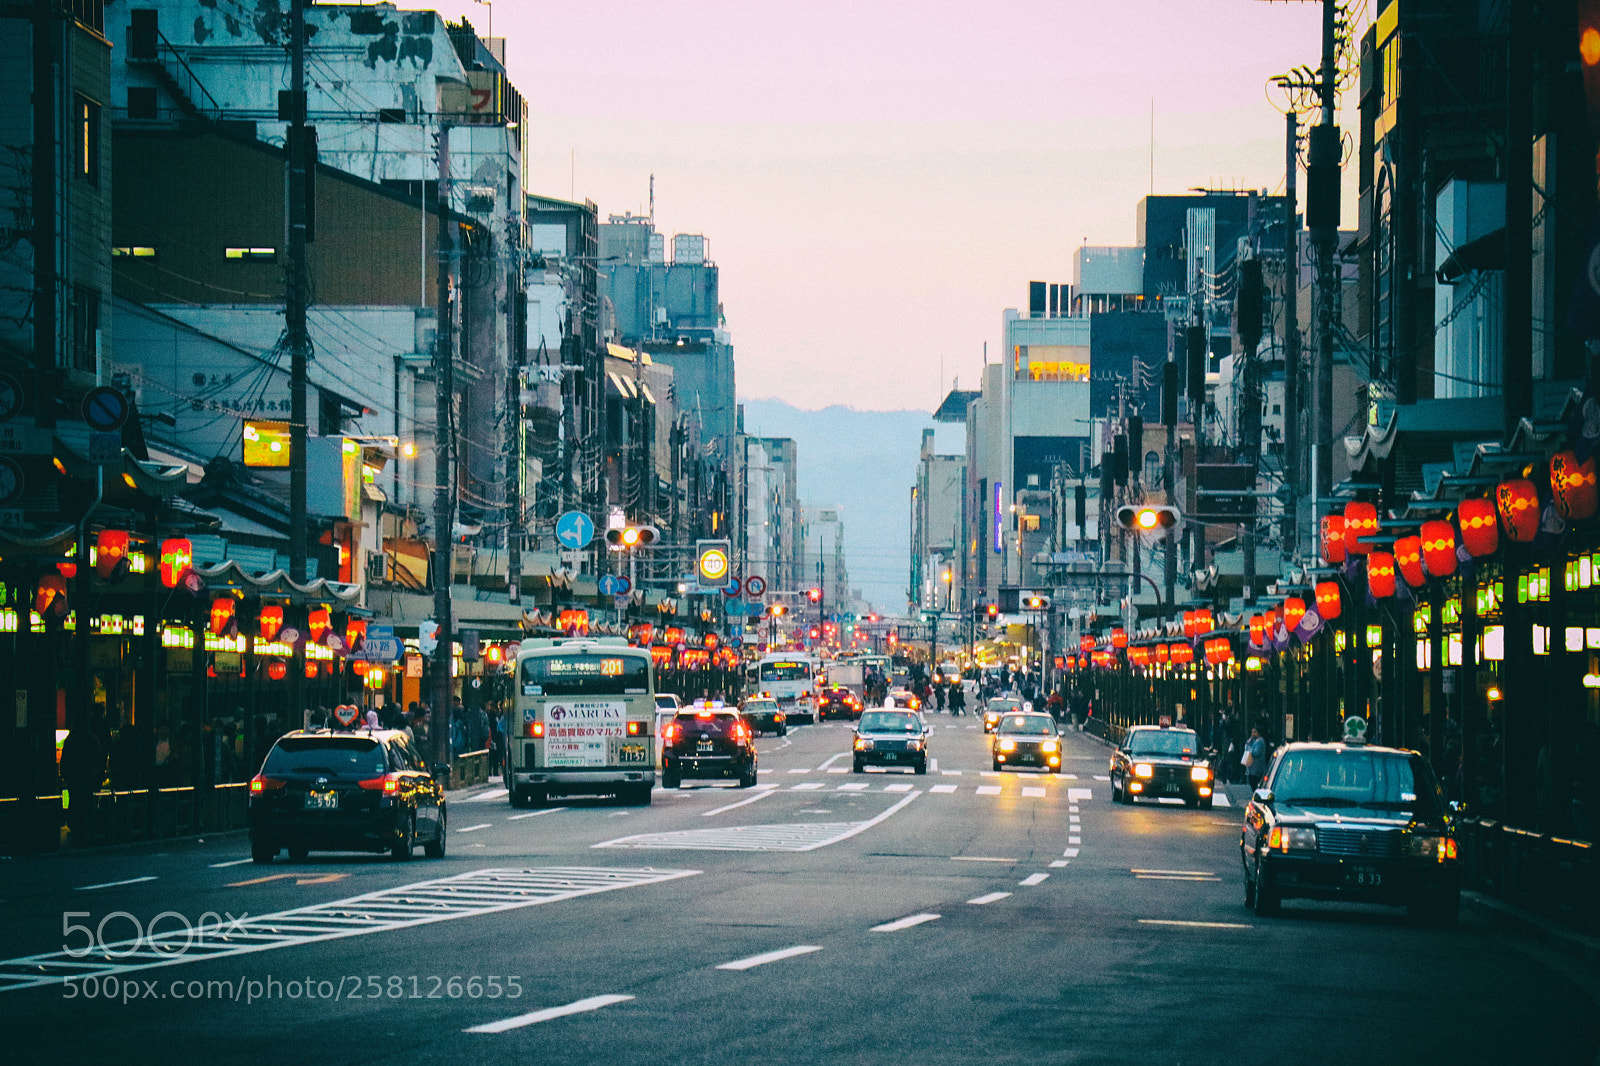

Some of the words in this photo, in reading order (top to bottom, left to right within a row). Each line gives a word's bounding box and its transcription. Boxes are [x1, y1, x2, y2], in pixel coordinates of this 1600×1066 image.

[602, 661, 622, 674] 201
[568, 709, 620, 718] MARUKA
[548, 727, 623, 738] 高価買取のマルカ
